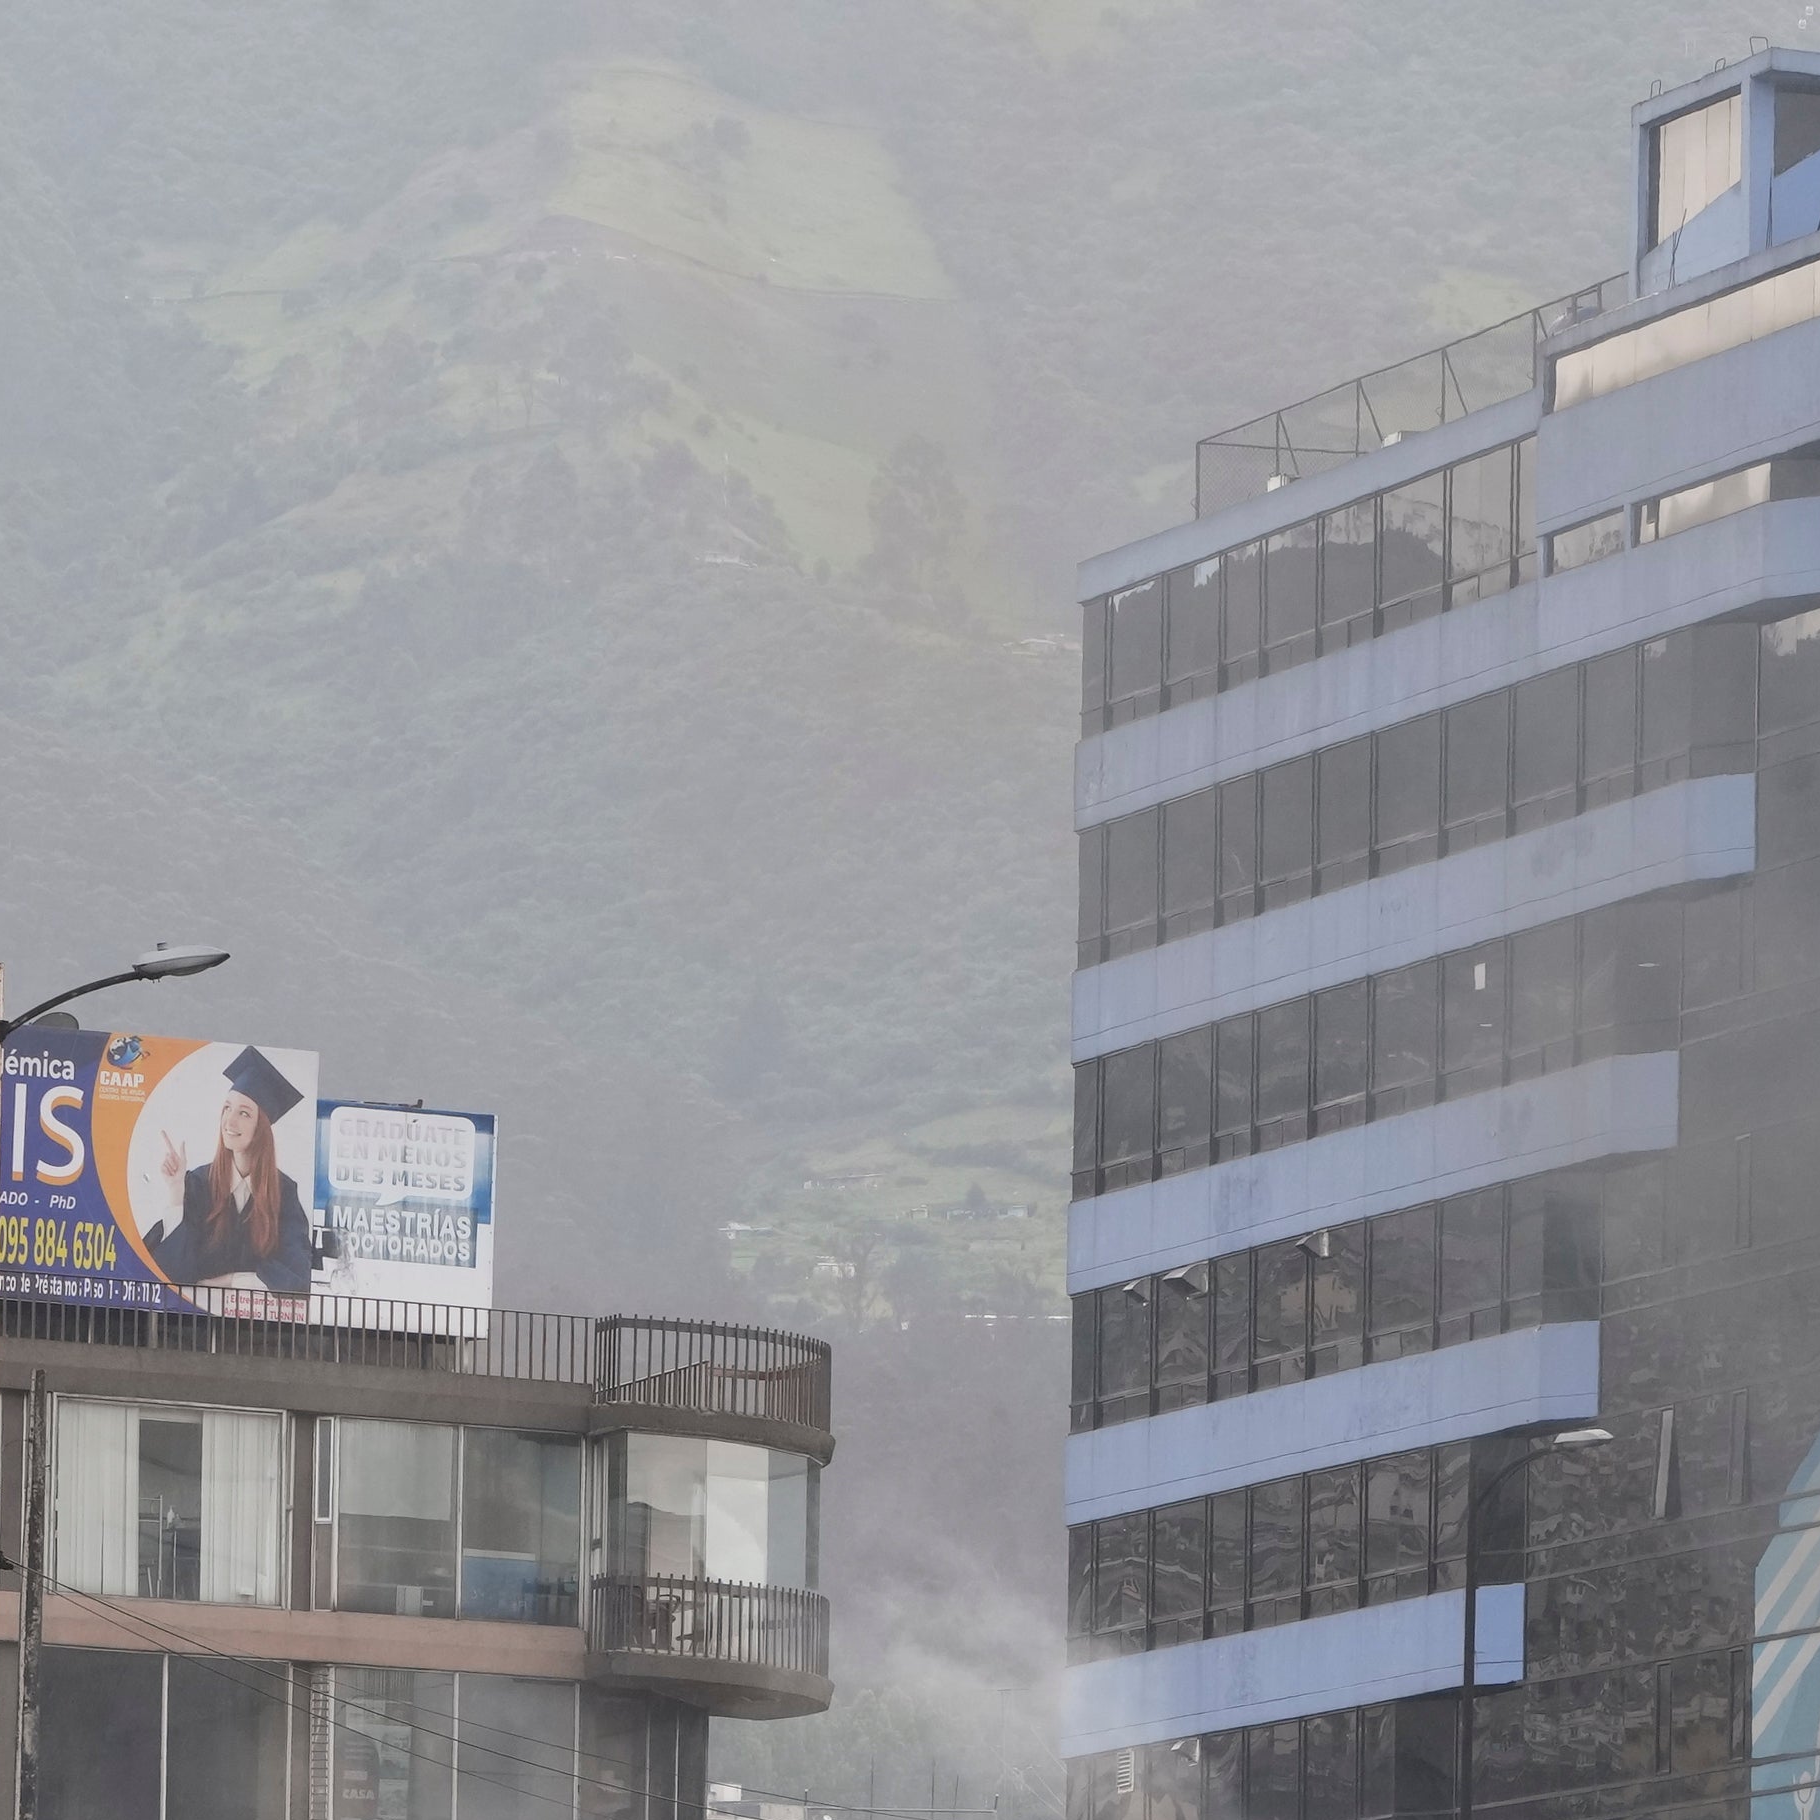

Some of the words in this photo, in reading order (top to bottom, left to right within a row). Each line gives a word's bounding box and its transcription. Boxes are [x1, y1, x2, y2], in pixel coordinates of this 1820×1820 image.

[99, 1070, 145, 1088] CAAP
[338, 1117, 469, 1147] GRADÚATE
[335, 1142, 369, 1160] EN
[377, 1145, 467, 1169] MENOS
[335, 1166, 365, 1183] DE
[372, 1168, 384, 1185] 3
[391, 1170, 466, 1192] MESES
[49, 1194, 77, 1210] PhD
[332, 1205, 471, 1240] MAESTRÍAS
[34, 1218, 68, 1267] 884
[73, 1221, 117, 1271] 6304
